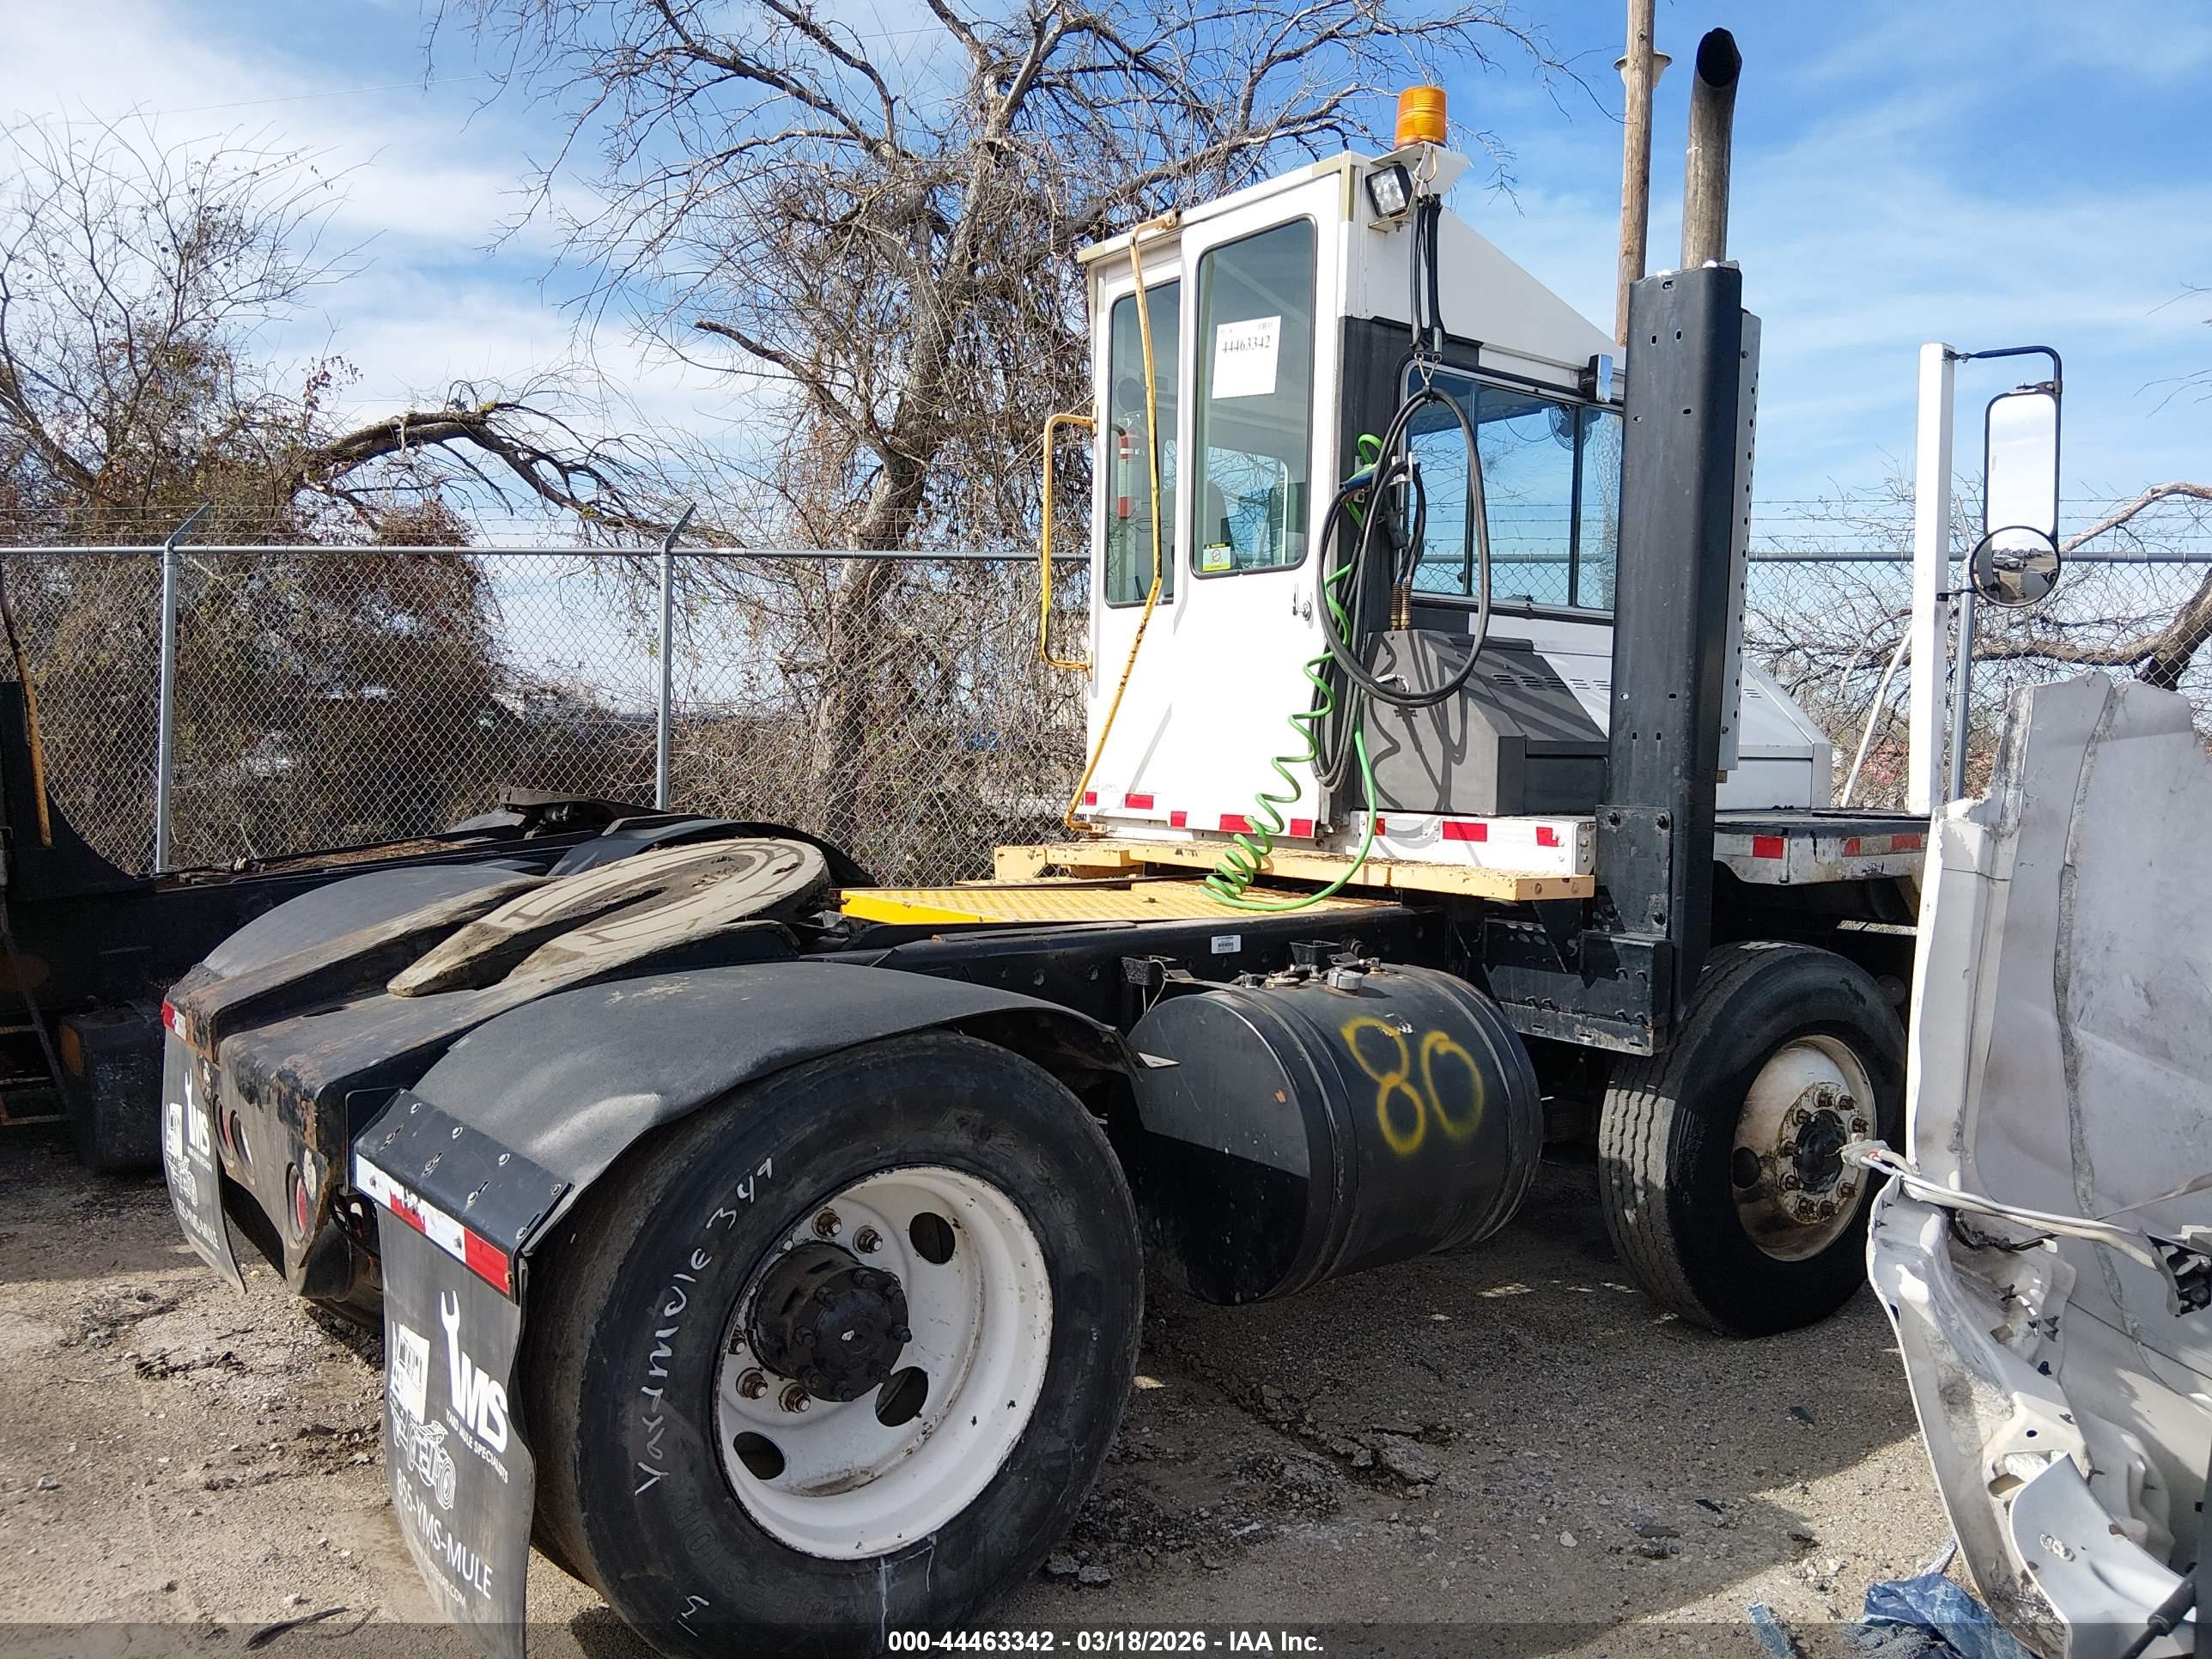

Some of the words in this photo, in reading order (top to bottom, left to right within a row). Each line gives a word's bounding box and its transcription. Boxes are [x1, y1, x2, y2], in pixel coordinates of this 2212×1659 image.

[1221, 334, 1271, 354] 44463342
[1339, 1015, 1485, 1157] 80
[446, 1407, 459, 1431] YARD
[459, 1425, 473, 1449] MULE
[474, 1440, 508, 1485] SPECIALISTS
[397, 1467, 493, 1600] 855-YMS-MULE
